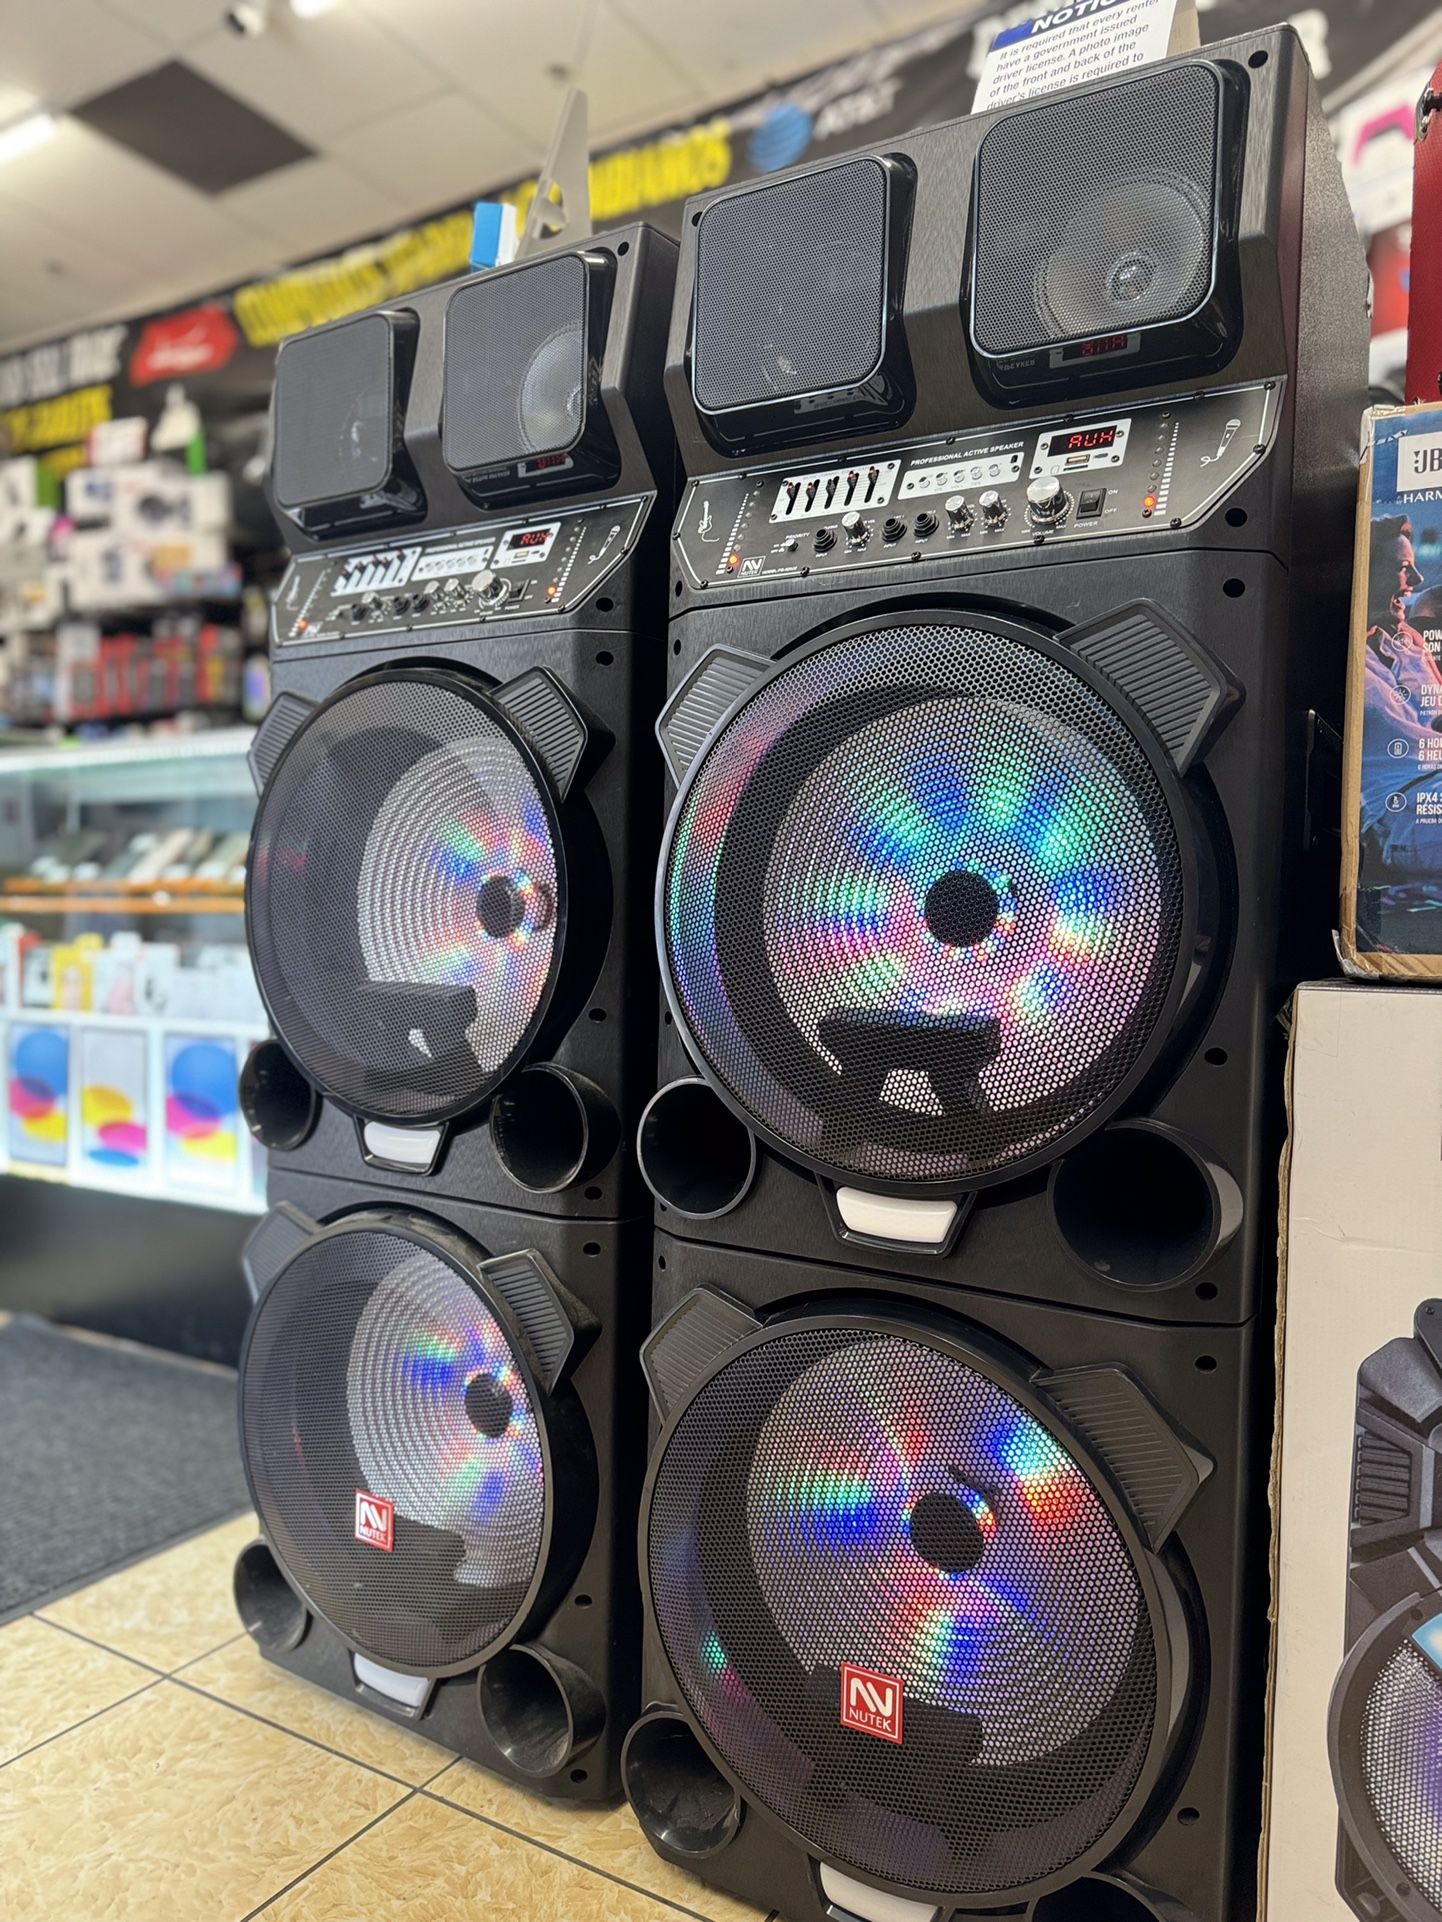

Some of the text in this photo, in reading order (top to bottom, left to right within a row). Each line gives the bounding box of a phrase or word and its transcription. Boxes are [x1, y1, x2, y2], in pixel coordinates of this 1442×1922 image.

[996, 15, 1138, 72] have a government issued
[1000, 51, 1008, 60] It
[1009, 48, 1018, 58] is
[1021, 31, 1066, 53] required
[1068, 21, 1090, 36] that
[1092, 11, 1124, 30] every
[993, 22, 1149, 85] driver license. A photo image
[990, 40, 1136, 98] of the front and back of the
[1028, 76, 1067, 99] license
[1069, 72, 1079, 84] is
[1082, 57, 1129, 81] required
[1132, 51, 1144, 63] to
[910, 441, 1024, 466] PROFESSIONAL ACTIVE SPEAKER
[1074, 520, 1099, 528] POWER
[1422, 641, 1440, 652] SON
[1421, 683, 1442, 695] DYN
[1420, 696, 1436, 708] JEU
[1418, 738, 1425, 749] 6
[1418, 750, 1424, 762] 6
[1417, 792, 1438, 804] IPX4
[360, 1524, 387, 1543] NUTEK
[849, 1707, 892, 1732] NUTEK
